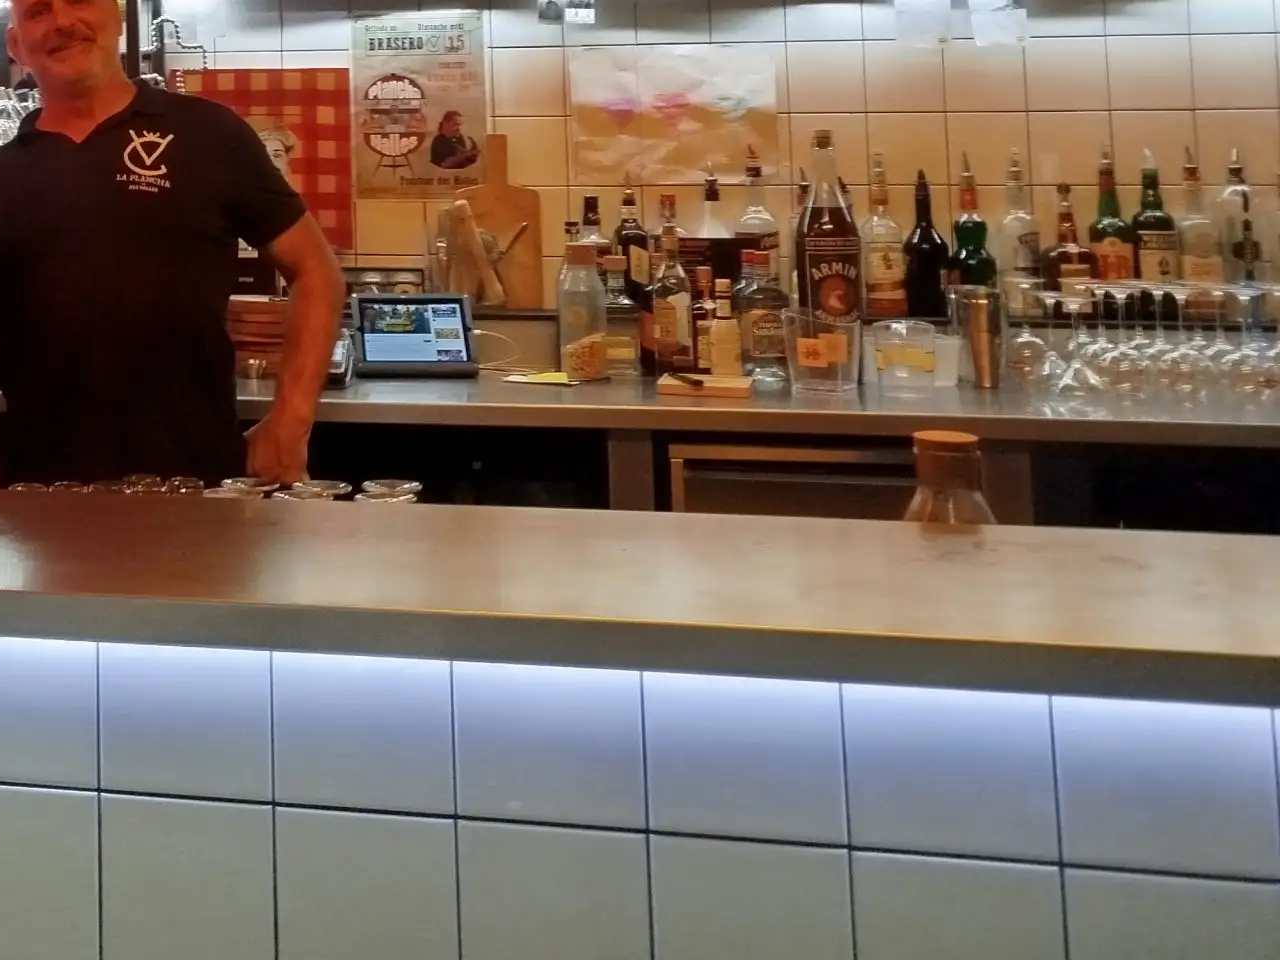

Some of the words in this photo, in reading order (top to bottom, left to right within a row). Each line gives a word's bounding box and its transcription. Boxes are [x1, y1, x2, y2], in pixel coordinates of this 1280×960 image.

[368, 36, 424, 51] BRASERO
[445, 34, 465, 51] 15
[116, 173, 127, 181] LA
[129, 174, 171, 188] PLANCHA
[811, 262, 858, 280] ARMIN
